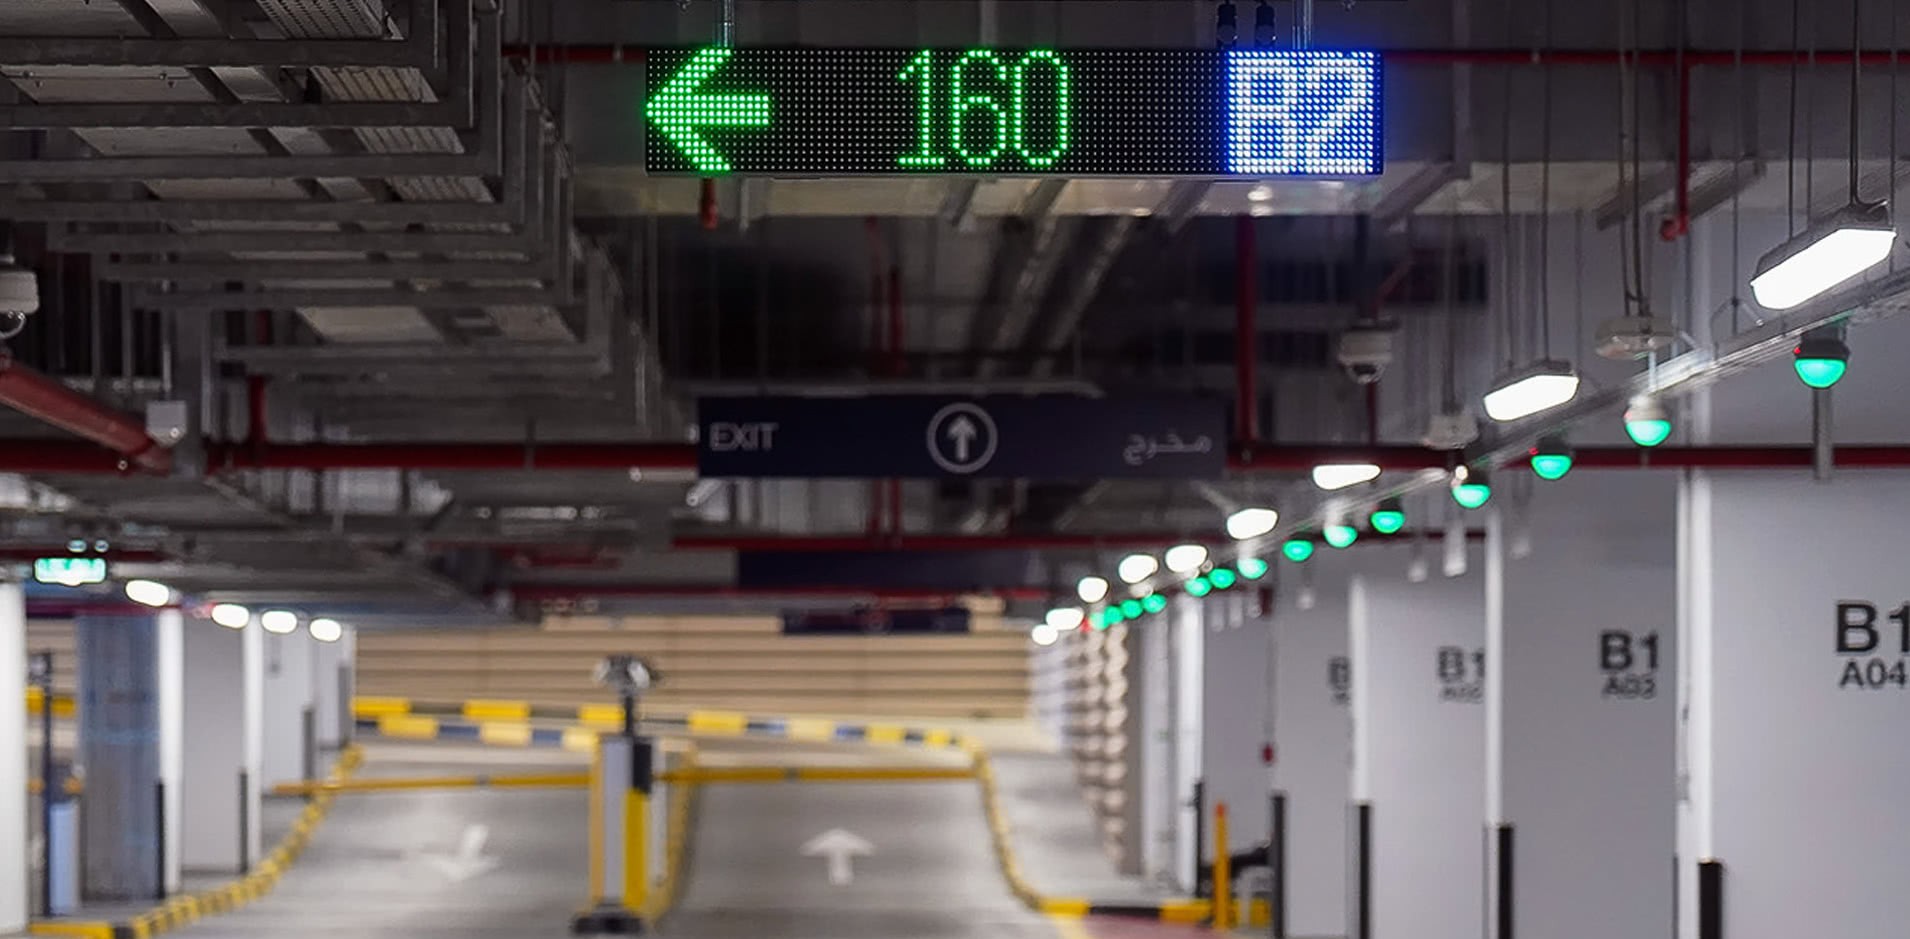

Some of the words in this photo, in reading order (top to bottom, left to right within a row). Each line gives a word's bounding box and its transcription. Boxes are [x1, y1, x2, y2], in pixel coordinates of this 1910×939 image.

[899, 50, 1068, 165] 160
[1234, 55, 1368, 174] B2
[710, 422, 779, 451] EXIT
[1123, 429, 1212, 466] مخرج
[1836, 602, 1910, 653] B1
[1601, 631, 1659, 670] B1
[1839, 660, 1906, 688] A04
